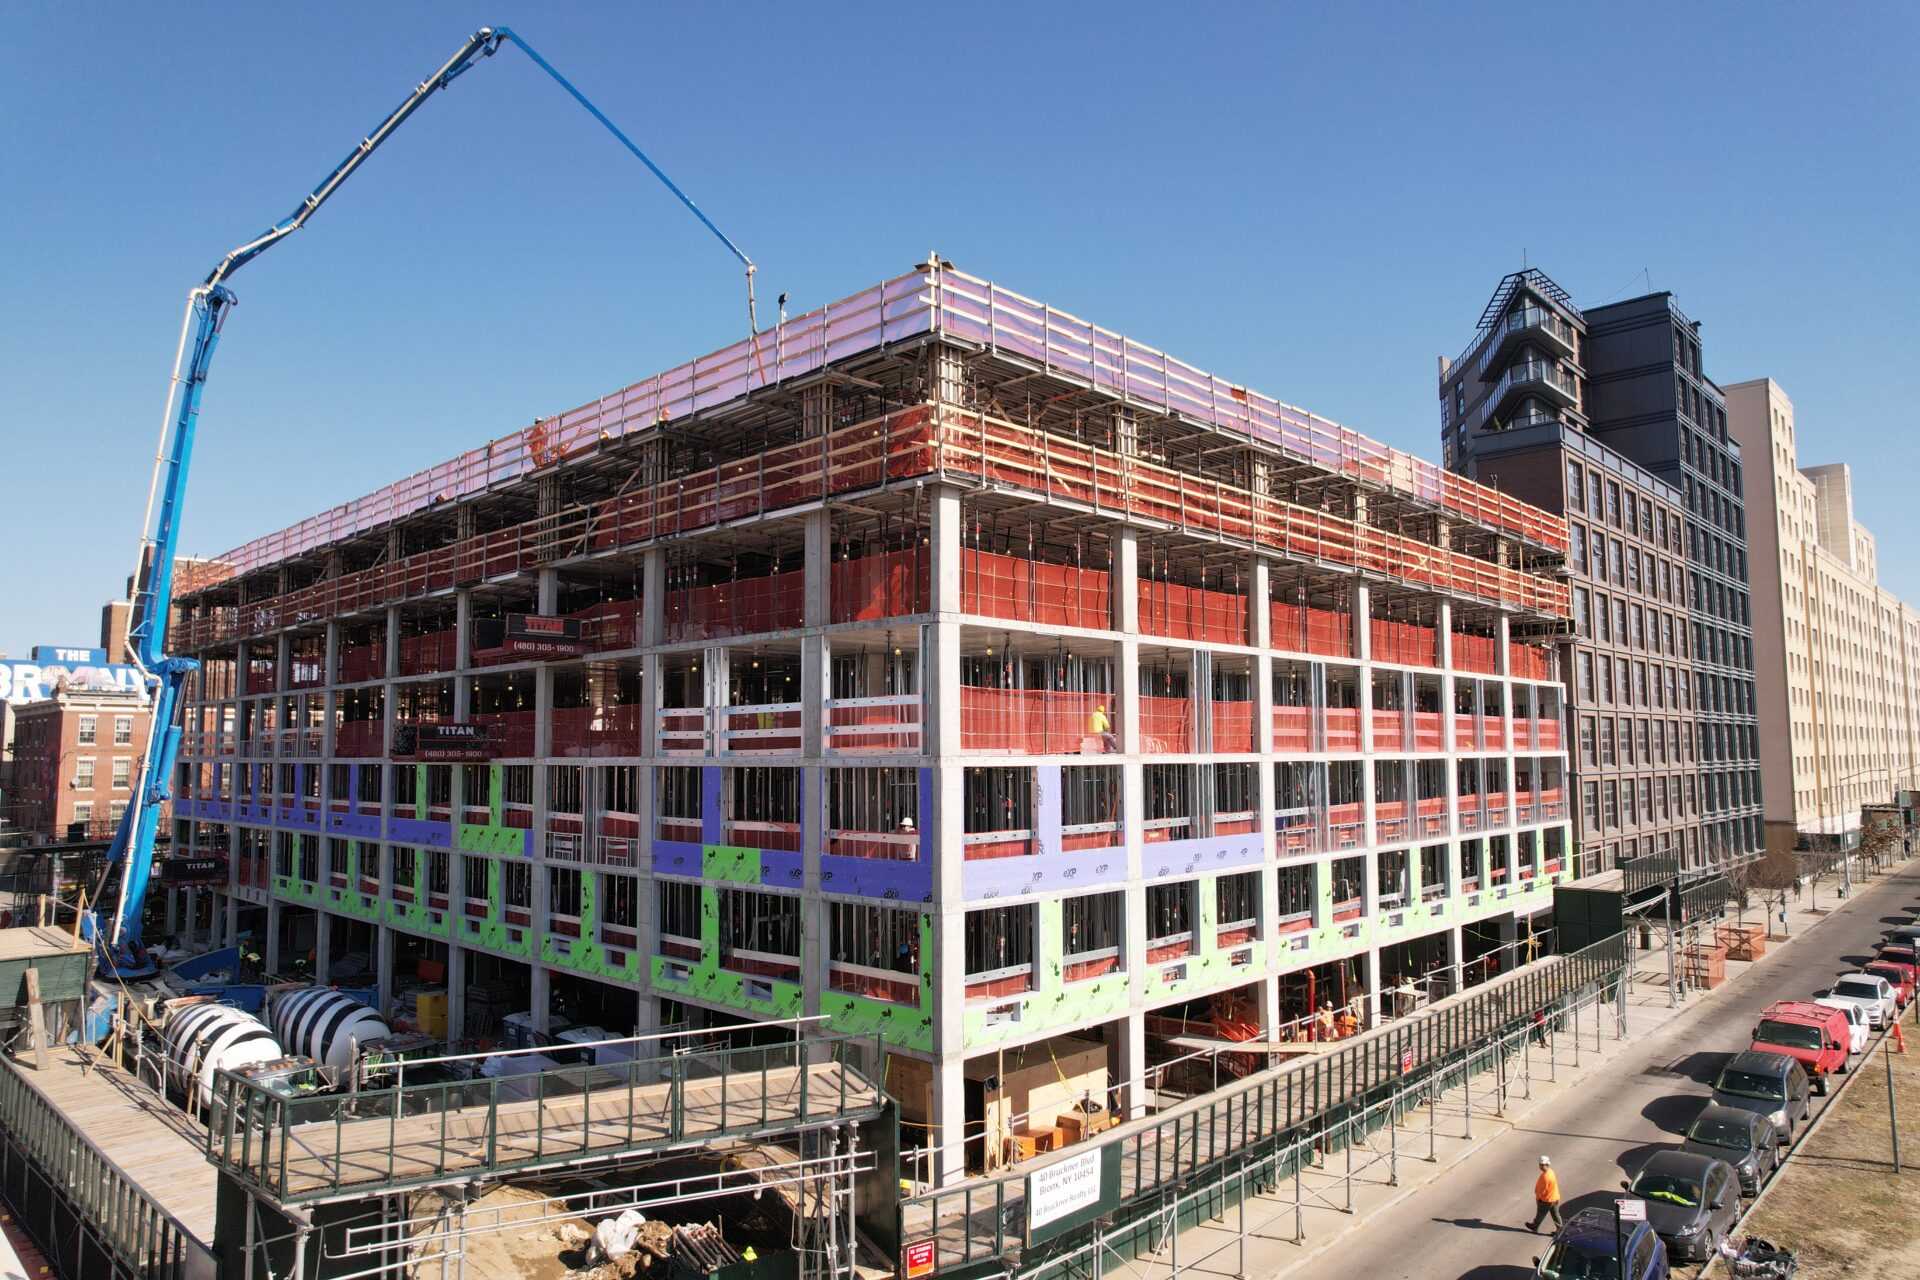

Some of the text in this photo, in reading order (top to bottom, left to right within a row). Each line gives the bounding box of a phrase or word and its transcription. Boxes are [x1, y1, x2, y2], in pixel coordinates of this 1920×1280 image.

[513, 640, 574, 653] (480) 305-1900
[55, 649, 91, 662] THE
[437, 726, 475, 736] TITAN
[424, 749, 445, 758] (480)
[186, 862, 215, 870] TITAN
[1063, 867, 1077, 878] eXP
[1039, 1153, 1095, 1182] 40 Bruckner Blvd
[1039, 1167, 1094, 1195] Bronx, NY 10454
[1035, 1184, 1096, 1217] 40 Bruckner Realty LLC
